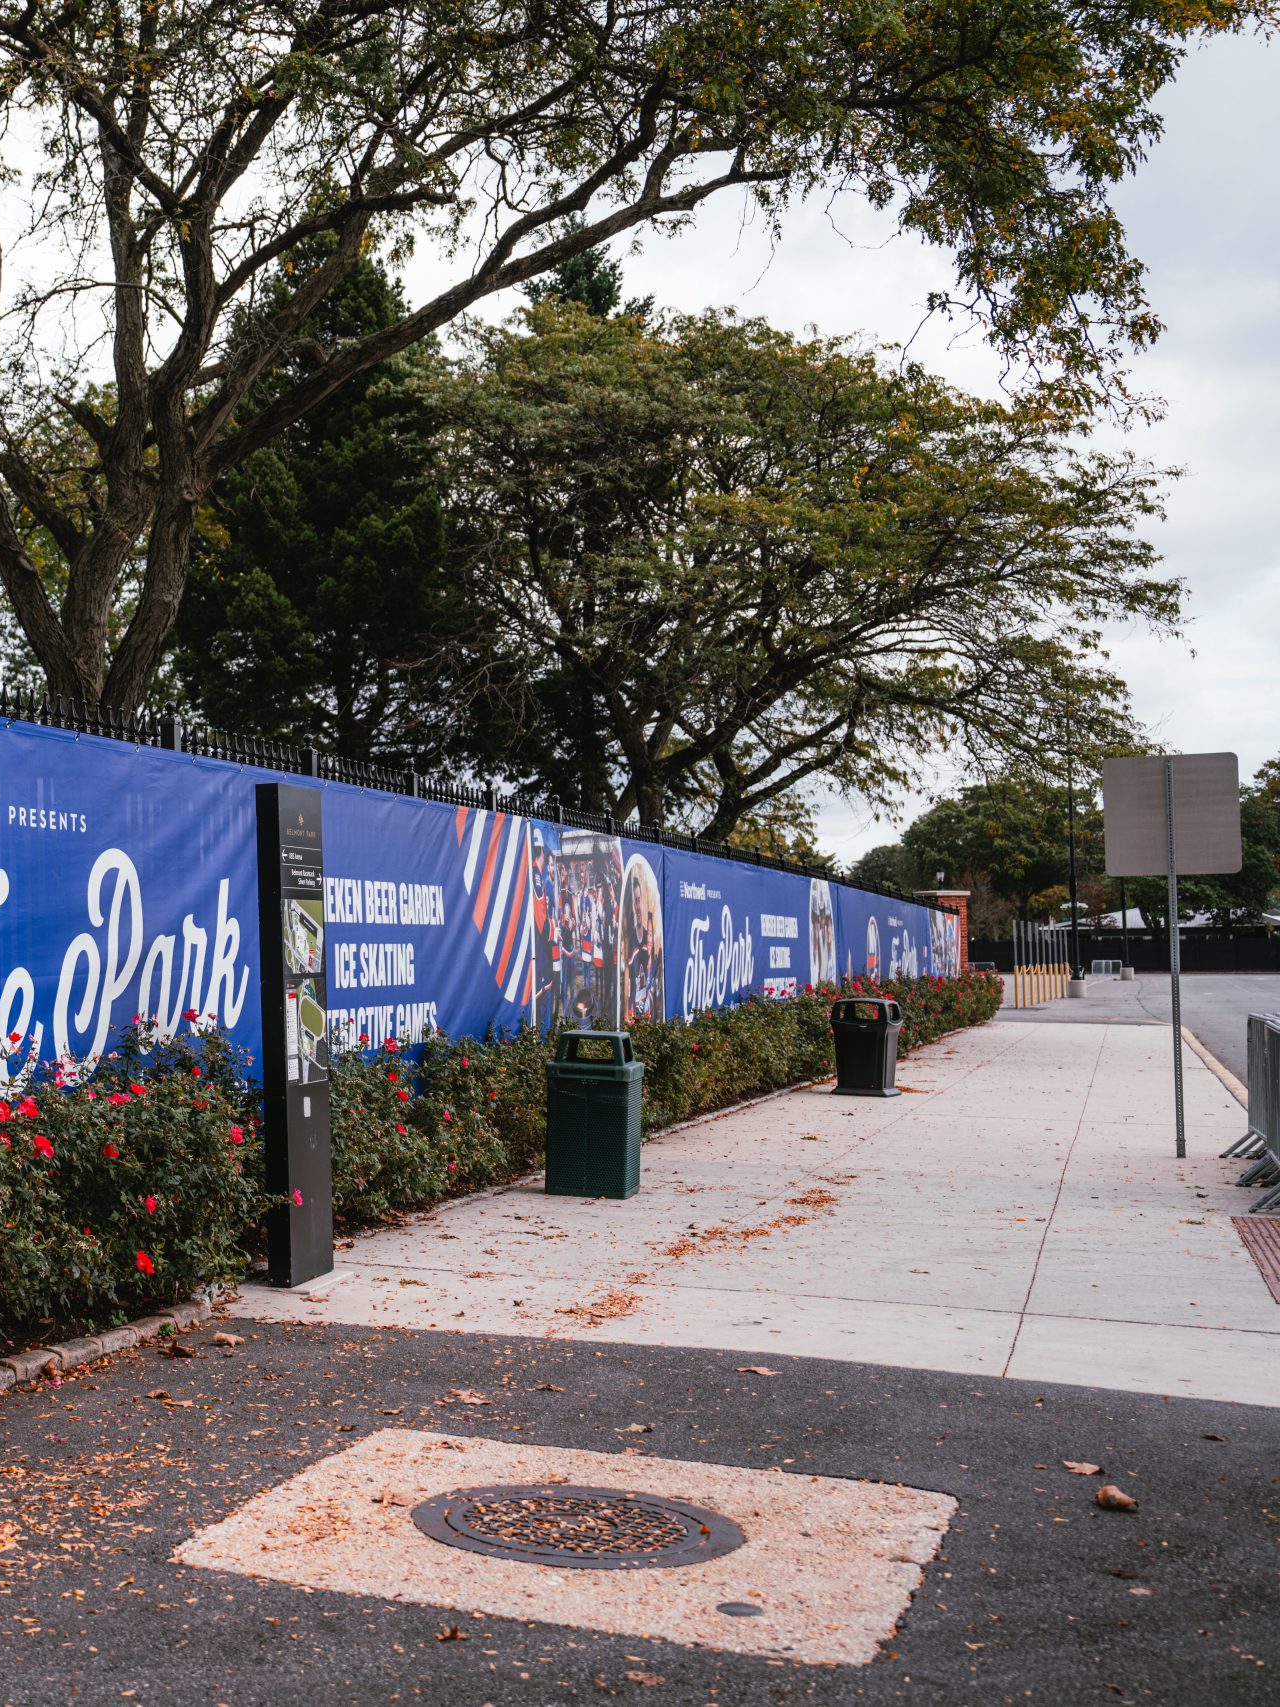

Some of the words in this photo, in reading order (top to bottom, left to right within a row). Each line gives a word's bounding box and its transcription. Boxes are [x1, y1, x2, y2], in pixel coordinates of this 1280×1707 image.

[8, 805, 88, 833] PRESENTS
[365, 880, 398, 925] BEER
[399, 882, 445, 926] GARDEN
[53, 847, 250, 1088] Park
[334, 942, 358, 989] ICE
[359, 942, 415, 988] SKATING
[683, 914, 716, 1024] The
[716, 904, 755, 1006] Park
[396, 1000, 439, 1047] GAMES
